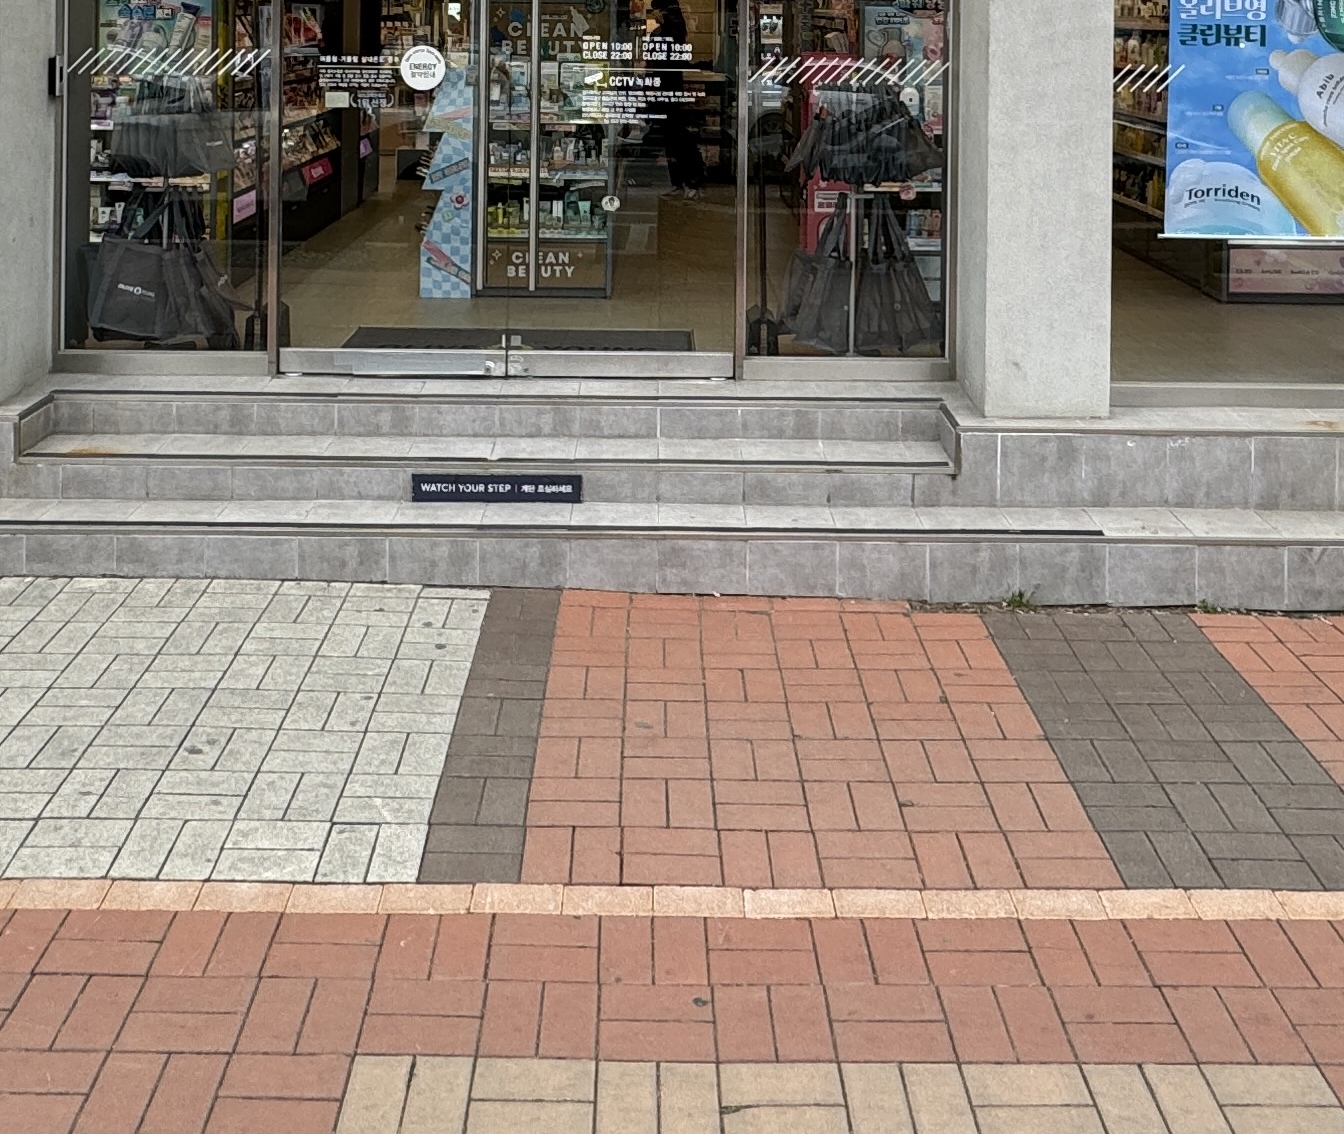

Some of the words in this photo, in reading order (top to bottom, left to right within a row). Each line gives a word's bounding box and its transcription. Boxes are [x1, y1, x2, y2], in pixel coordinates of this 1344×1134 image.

[1176, 23, 1267, 48] 클린뷰티
[582, 41, 608, 51] OPEN
[642, 42, 668, 51] OPEN
[582, 51, 608, 60] CLOSE
[642, 52, 668, 61] CLOSE
[609, 76, 635, 87] CCTV
[1316, 73, 1335, 100] Abib
[1185, 183, 1261, 206] Torriden
[507, 265, 576, 278] BEUTY
[420, 482, 456, 493] WATCH
[458, 483, 485, 493] YOUR
[487, 483, 512, 493] STEP
